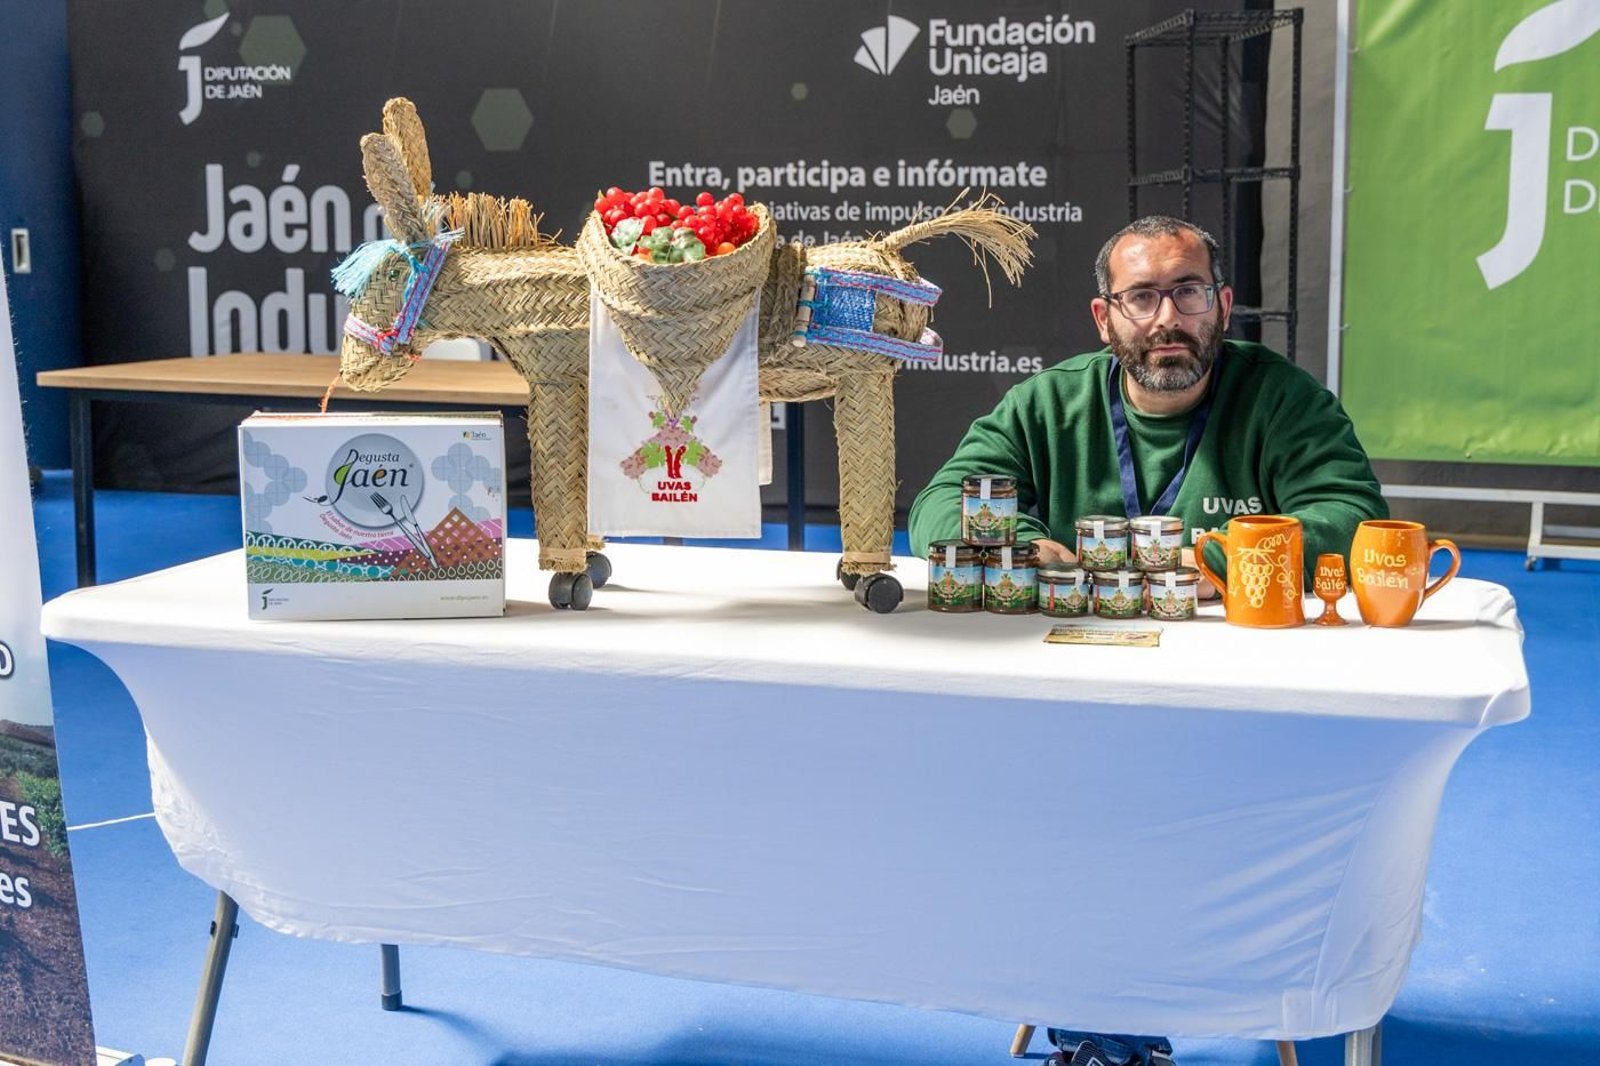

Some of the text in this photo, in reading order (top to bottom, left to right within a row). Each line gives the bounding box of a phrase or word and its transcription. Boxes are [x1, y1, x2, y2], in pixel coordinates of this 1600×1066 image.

[928, 14, 1096, 47] Fundación
[204, 64, 291, 81] DIPUTACIÓN
[928, 45, 1049, 82] Unicaja
[204, 82, 263, 99] DE JAÉN
[928, 84, 980, 105] Jaén
[648, 158, 1048, 194] Entra, participa e infórmate
[188, 163, 351, 253] Jaén
[834, 201, 861, 221] de
[991, 201, 1082, 222] ndustria
[187, 266, 351, 357] Indu
[651, 491, 698, 502] BAILÉN
[657, 481, 692, 491] UVAS
[1203, 496, 1263, 515] UVAS
[1363, 548, 1407, 568] Uvas
[1356, 567, 1409, 590] Bailén
[0, 800, 40, 847] ES
[0, 872, 33, 908] es
